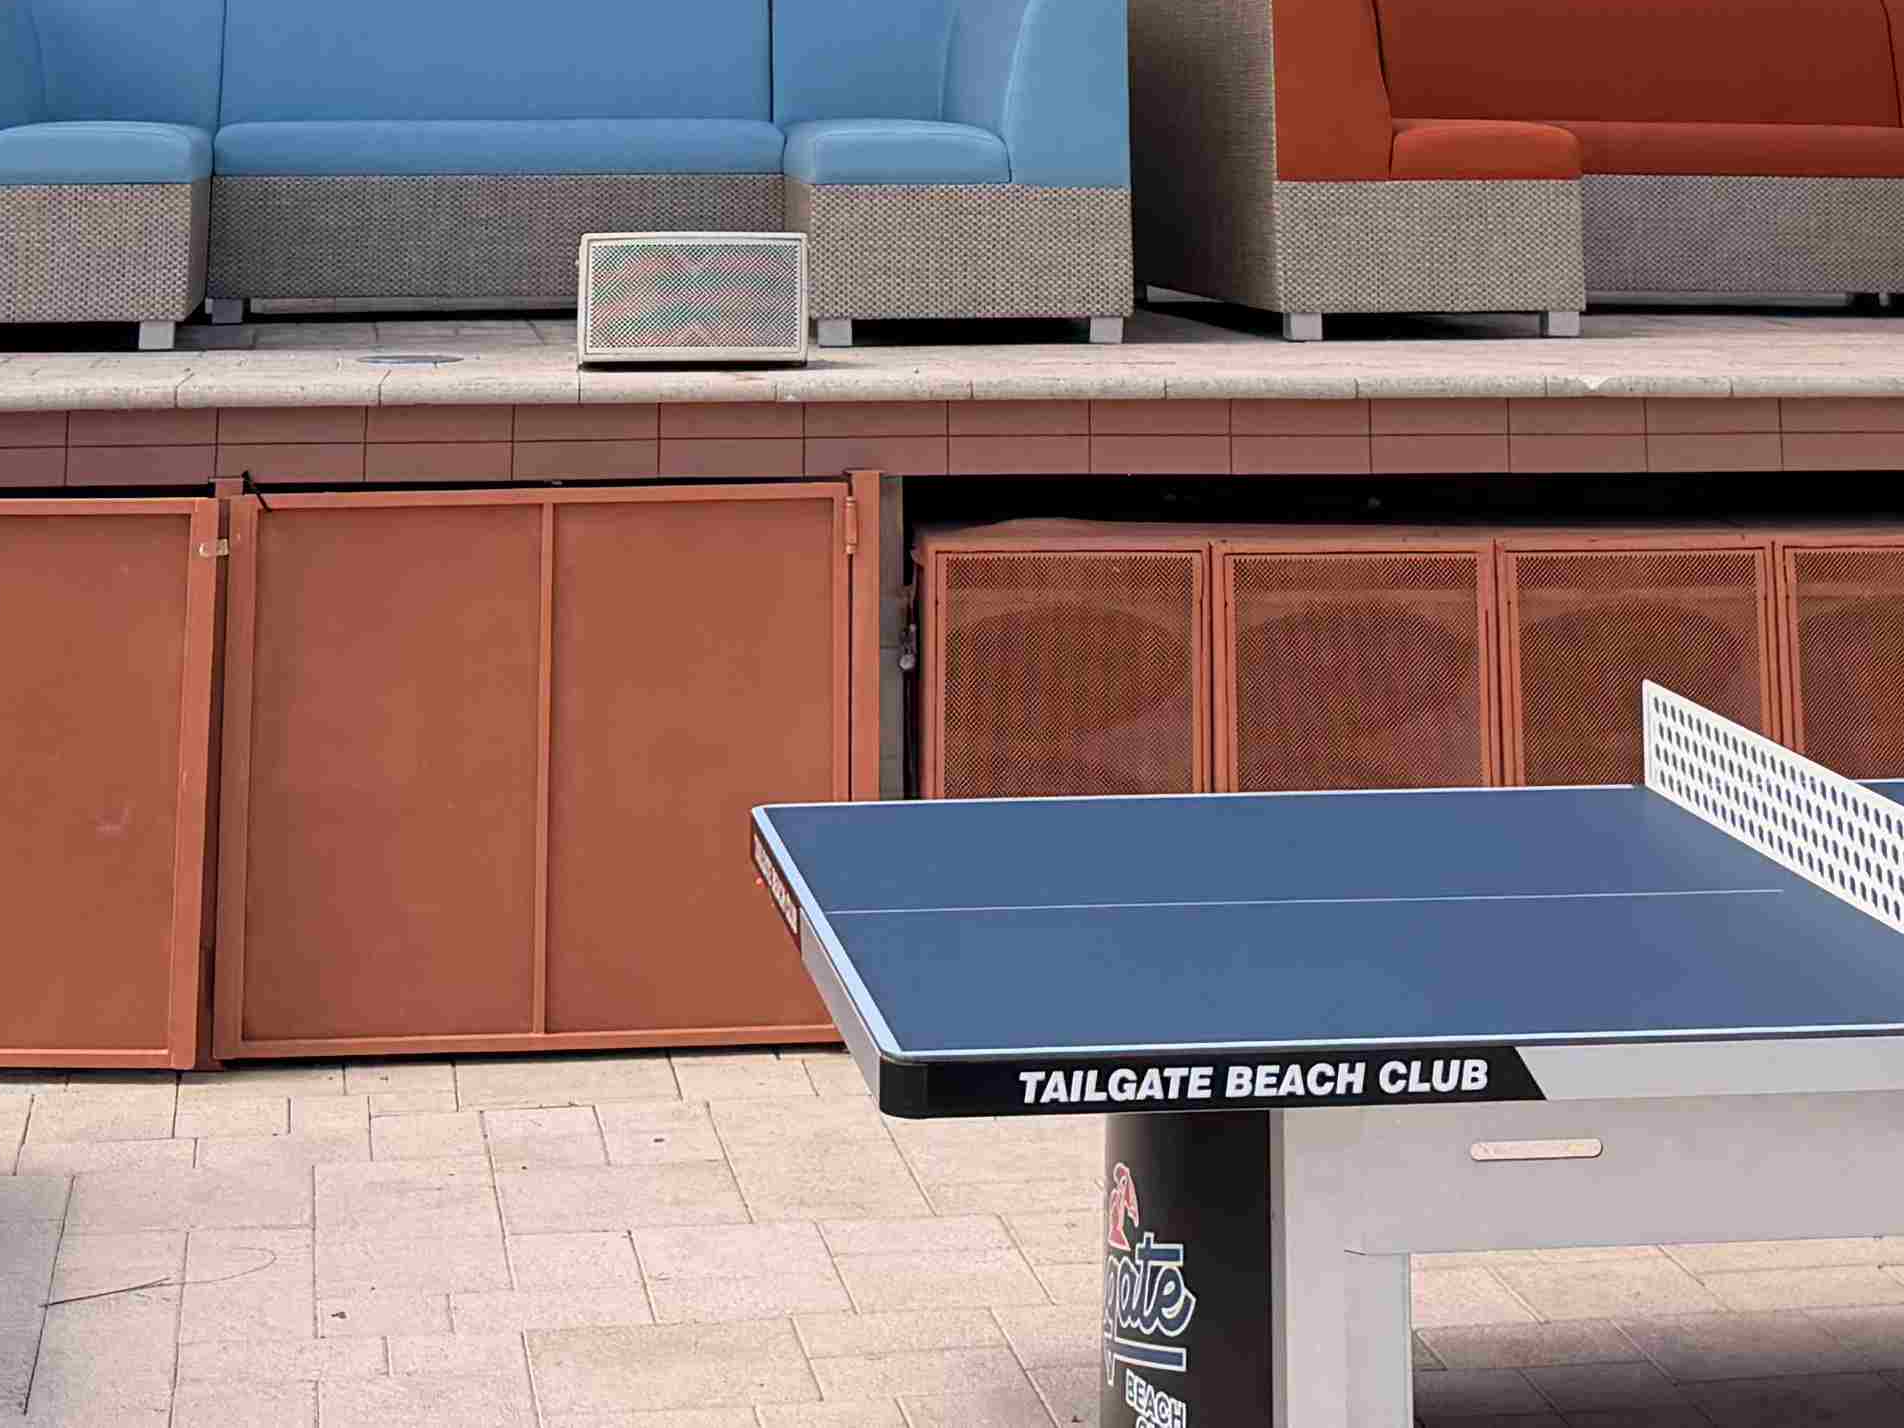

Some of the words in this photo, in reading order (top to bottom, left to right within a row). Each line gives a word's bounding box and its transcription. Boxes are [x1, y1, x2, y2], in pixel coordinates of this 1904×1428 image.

[1018, 1067, 1213, 1104] TAILGATE
[1224, 1061, 1366, 1099] BEACH
[1378, 1058, 1489, 1094] CLUB
